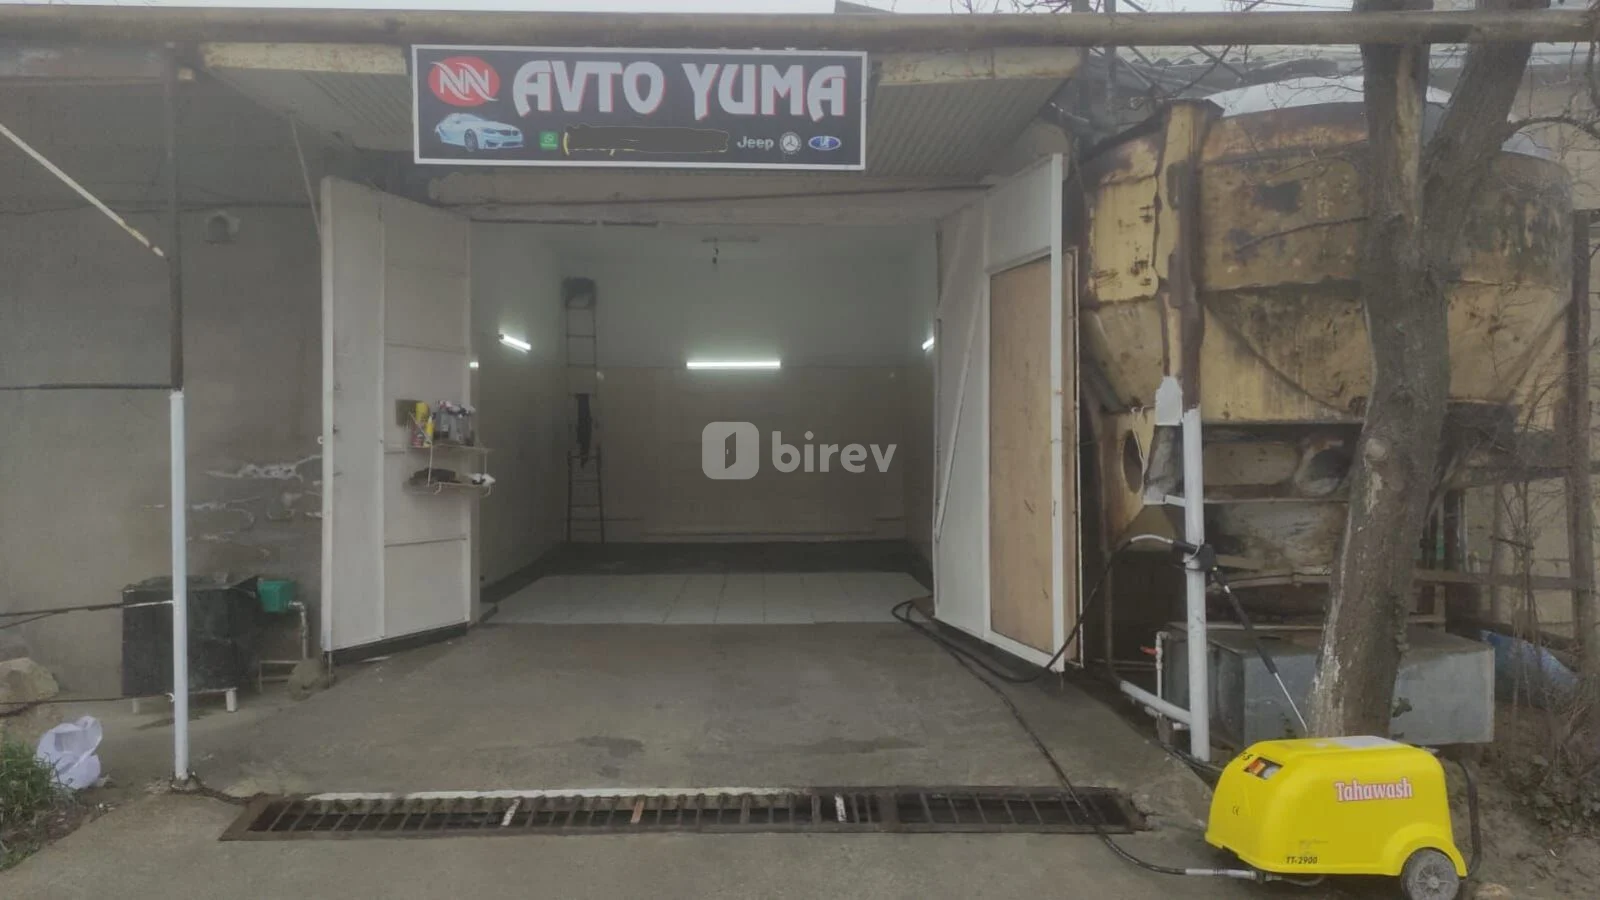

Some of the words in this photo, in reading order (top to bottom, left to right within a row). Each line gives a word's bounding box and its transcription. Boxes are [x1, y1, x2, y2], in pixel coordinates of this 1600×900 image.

[512, 60, 665, 117] AVTO
[682, 63, 846, 121] YUMA
[736, 136, 774, 150] Jeep
[1335, 777, 1413, 802] Tahawash
